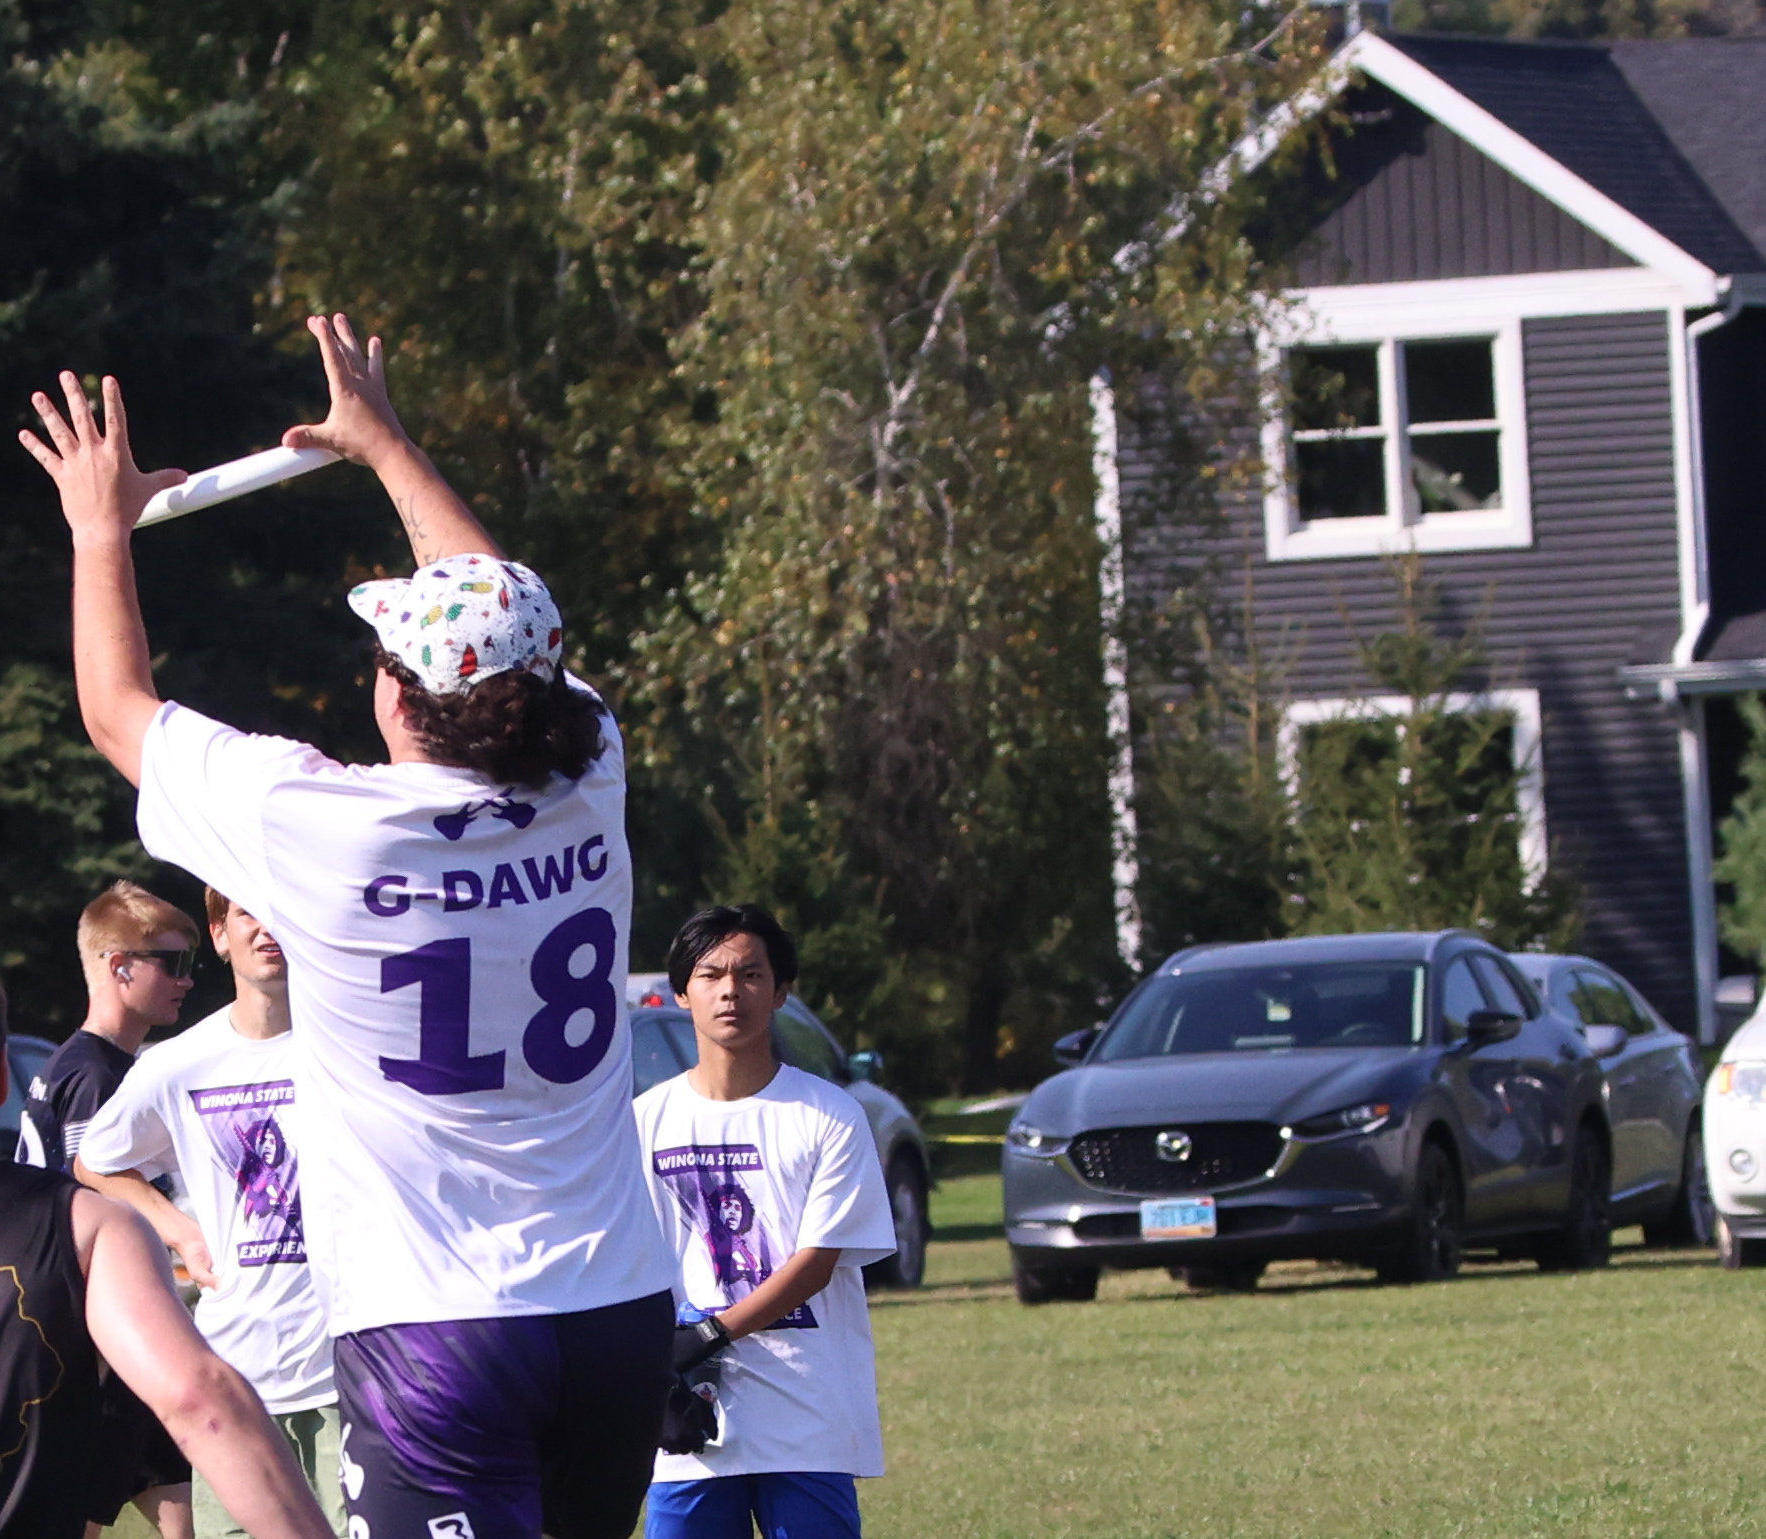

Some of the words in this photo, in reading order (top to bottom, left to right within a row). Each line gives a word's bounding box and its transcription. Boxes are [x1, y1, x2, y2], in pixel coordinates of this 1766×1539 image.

[379, 907, 616, 1096] 18
[200, 1091, 253, 1109] WINONA
[255, 1086, 294, 1103] STATE
[658, 1153, 715, 1170] WINONA
[718, 1152, 759, 1166] STATE
